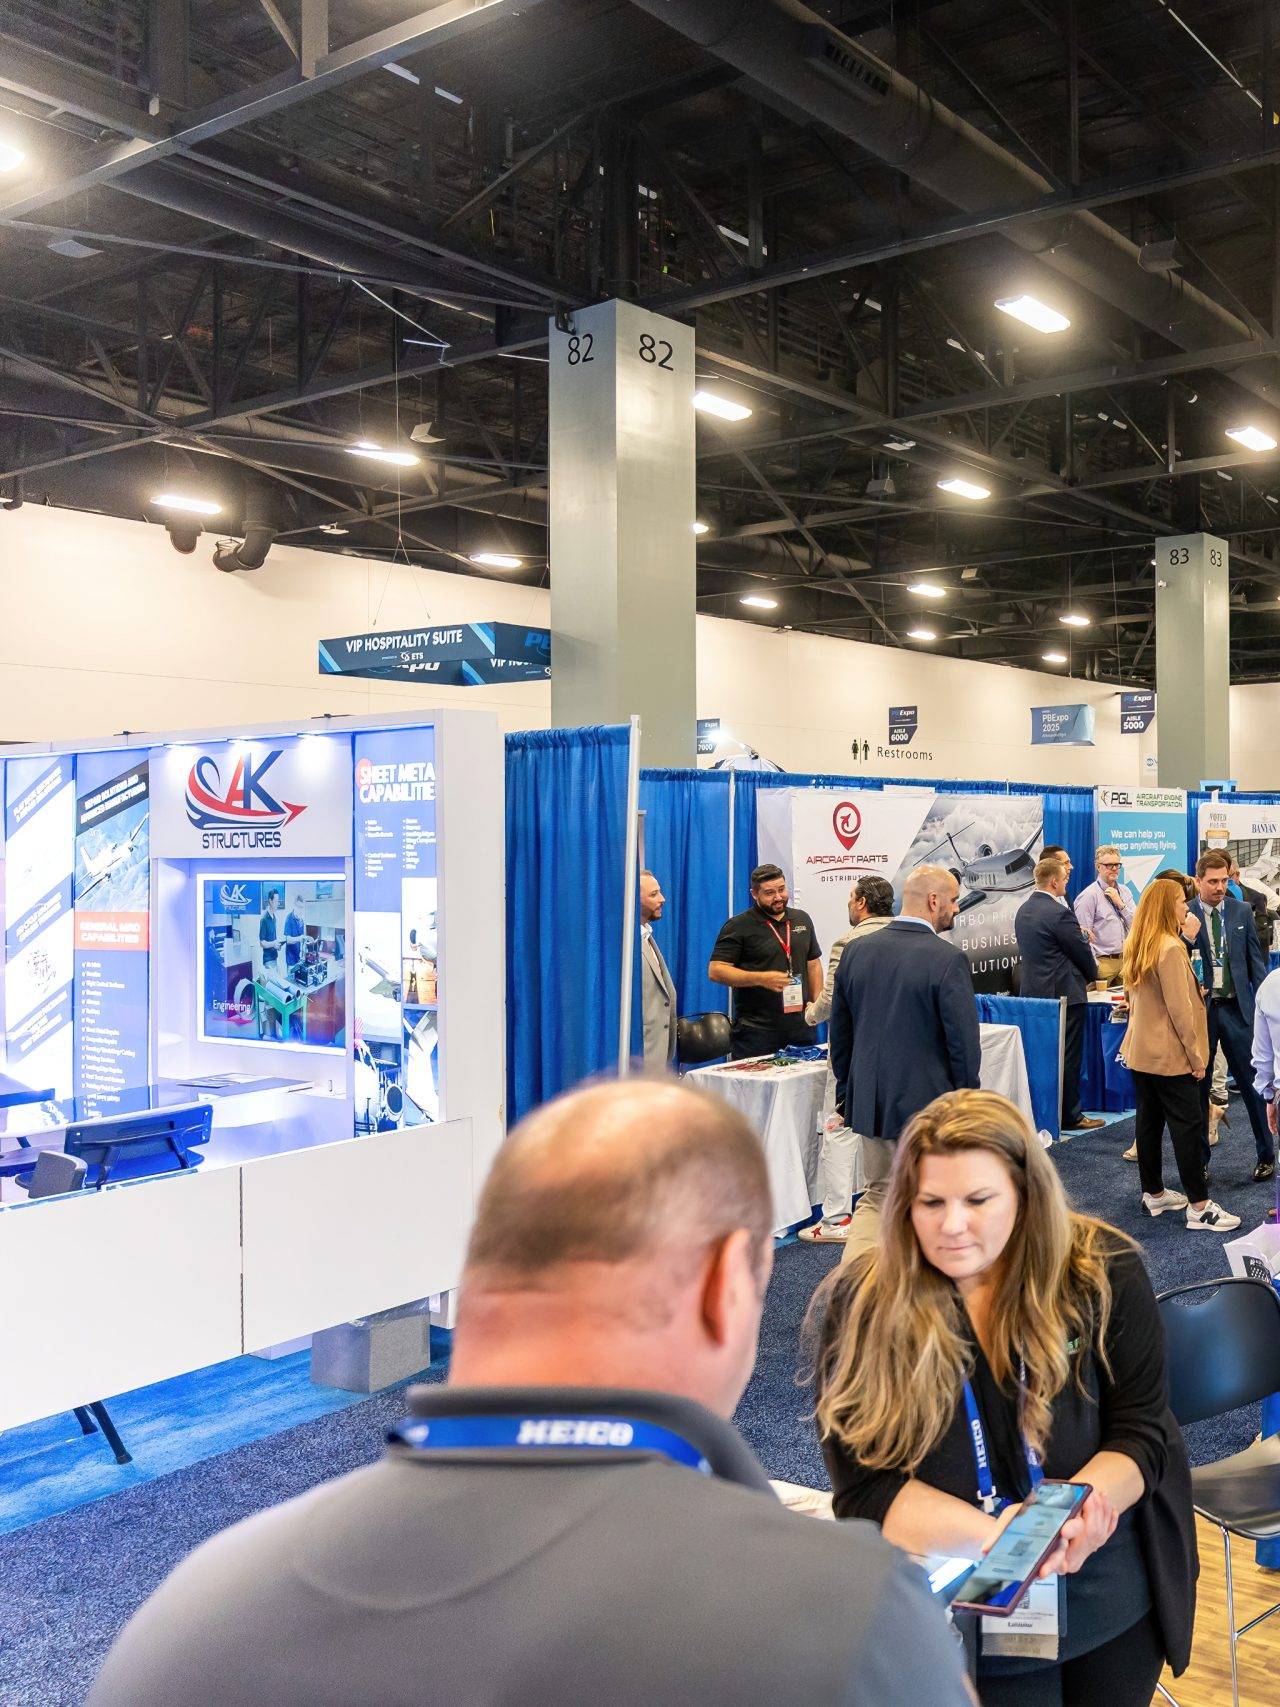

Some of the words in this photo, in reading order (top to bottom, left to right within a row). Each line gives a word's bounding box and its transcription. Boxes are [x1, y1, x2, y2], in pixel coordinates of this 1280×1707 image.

[567, 333, 594, 365] 82
[639, 334, 674, 371] 82
[1169, 547, 1190, 565] 83
[1210, 549, 1222, 567] 83
[346, 640, 363, 653] VIP
[364, 632, 430, 651] HOSPITALITY
[432, 629, 463, 643] SUITE
[411, 652, 424, 660] ETS
[1042, 713, 1069, 722] PBExpo
[1042, 723, 1060, 732] 2025
[1123, 721, 1144, 730] 5000
[891, 733, 909, 742] 6000
[877, 746, 933, 761] Restrooms
[360, 765, 397, 785] SHEET
[398, 762, 436, 782] META
[360, 781, 437, 804] CAPABILITIE
[1111, 792, 1132, 805] PGL
[1136, 800, 1183, 808] TRANSPORTATION
[1111, 830, 1123, 838] We
[1138, 830, 1153, 839] help
[1153, 831, 1166, 839] you
[1252, 824, 1277, 833] BANYAN
[202, 831, 281, 849] STRUCTURES
[1129, 841, 1158, 852] anything
[1159, 840, 1178, 851] flying.
[806, 855, 856, 865] AIRCRAFT
[857, 854, 888, 863] PARTS
[962, 933, 1017, 951] BUSINES
[972, 955, 1022, 974] LUTION
[212, 1000, 252, 1014] Engineering
[516, 1420, 634, 1447] HEICO
